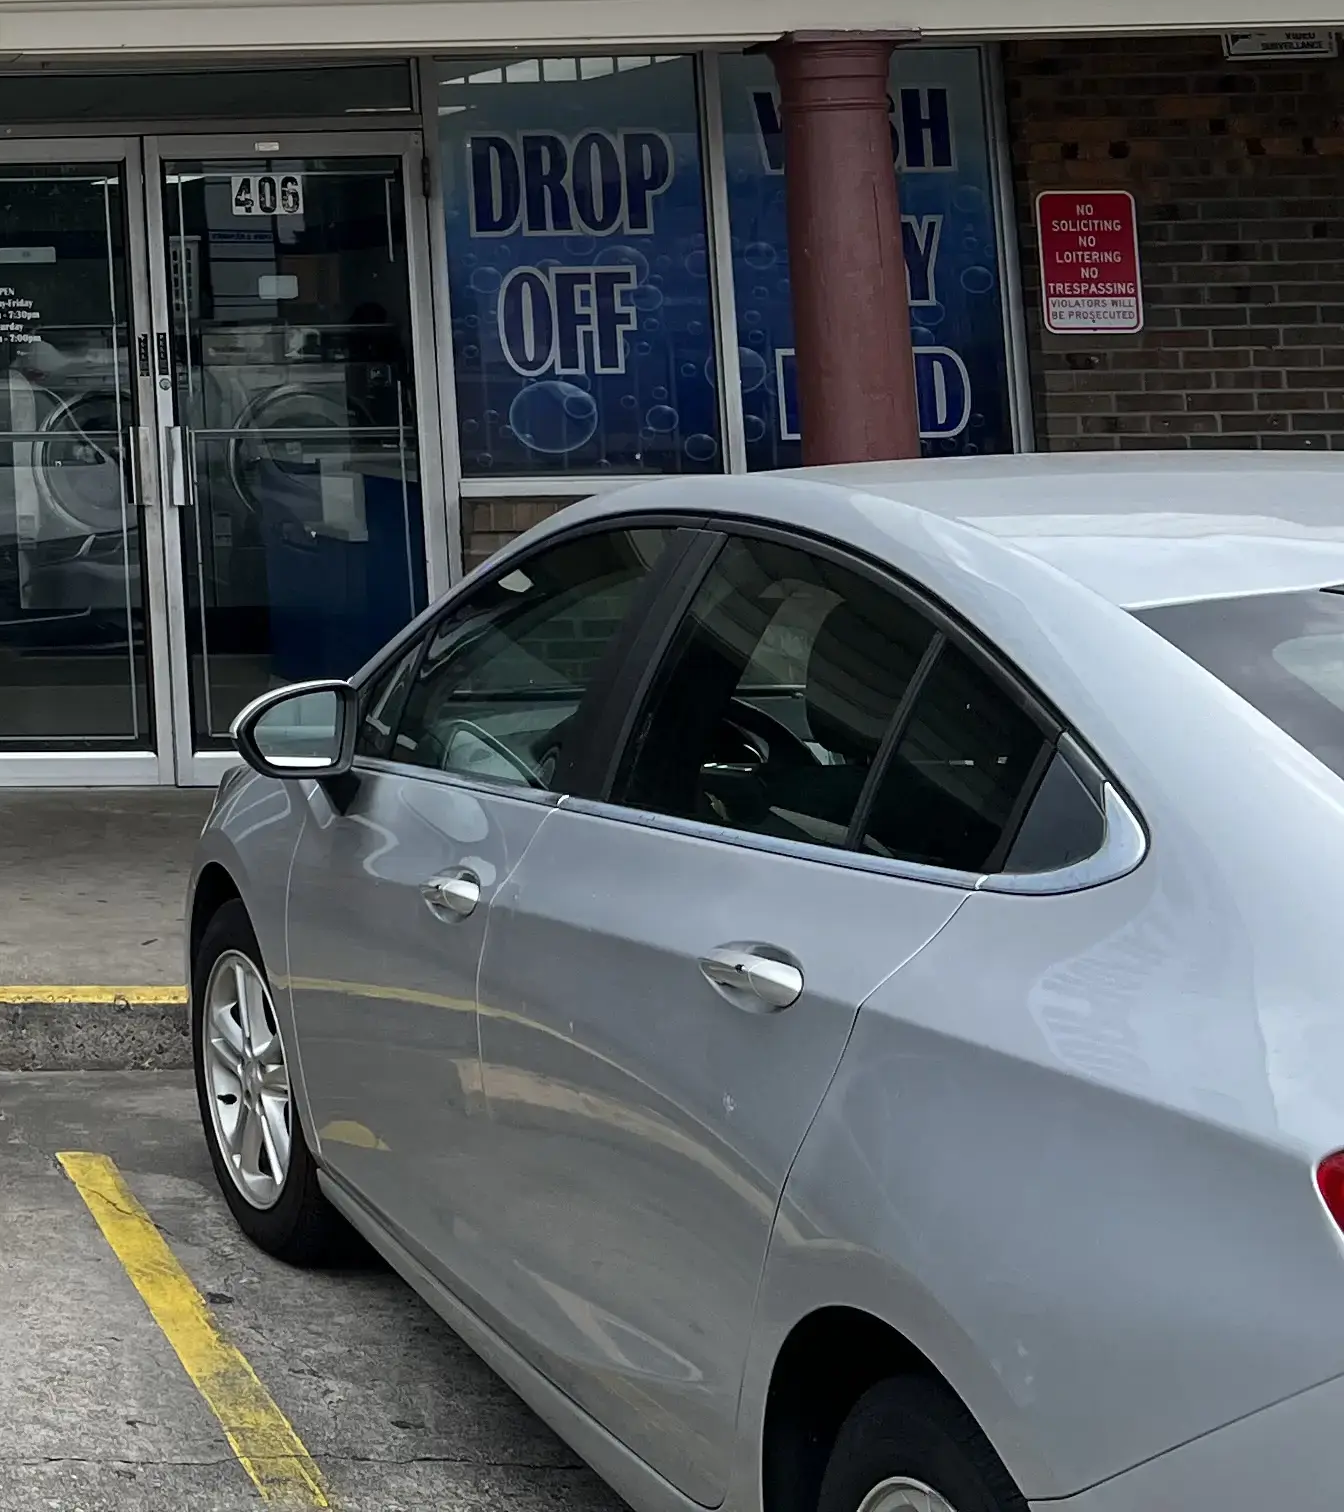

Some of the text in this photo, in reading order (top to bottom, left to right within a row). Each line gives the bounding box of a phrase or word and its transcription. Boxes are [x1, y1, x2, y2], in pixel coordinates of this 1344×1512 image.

[466, 127, 675, 238] DROP
[234, 176, 300, 213] 406
[1076, 204, 1094, 216] NO
[1051, 220, 1122, 232] SOLICITING
[1078, 236, 1096, 247] NO
[1056, 251, 1122, 263] LOITERING
[1081, 267, 1099, 279] NO
[1048, 282, 1135, 295] TRESPASSING
[1051, 299, 1134, 308] VIOLATORS WILL
[496, 265, 638, 377] OFF
[1052, 310, 1135, 320] BE PROSECUTED
